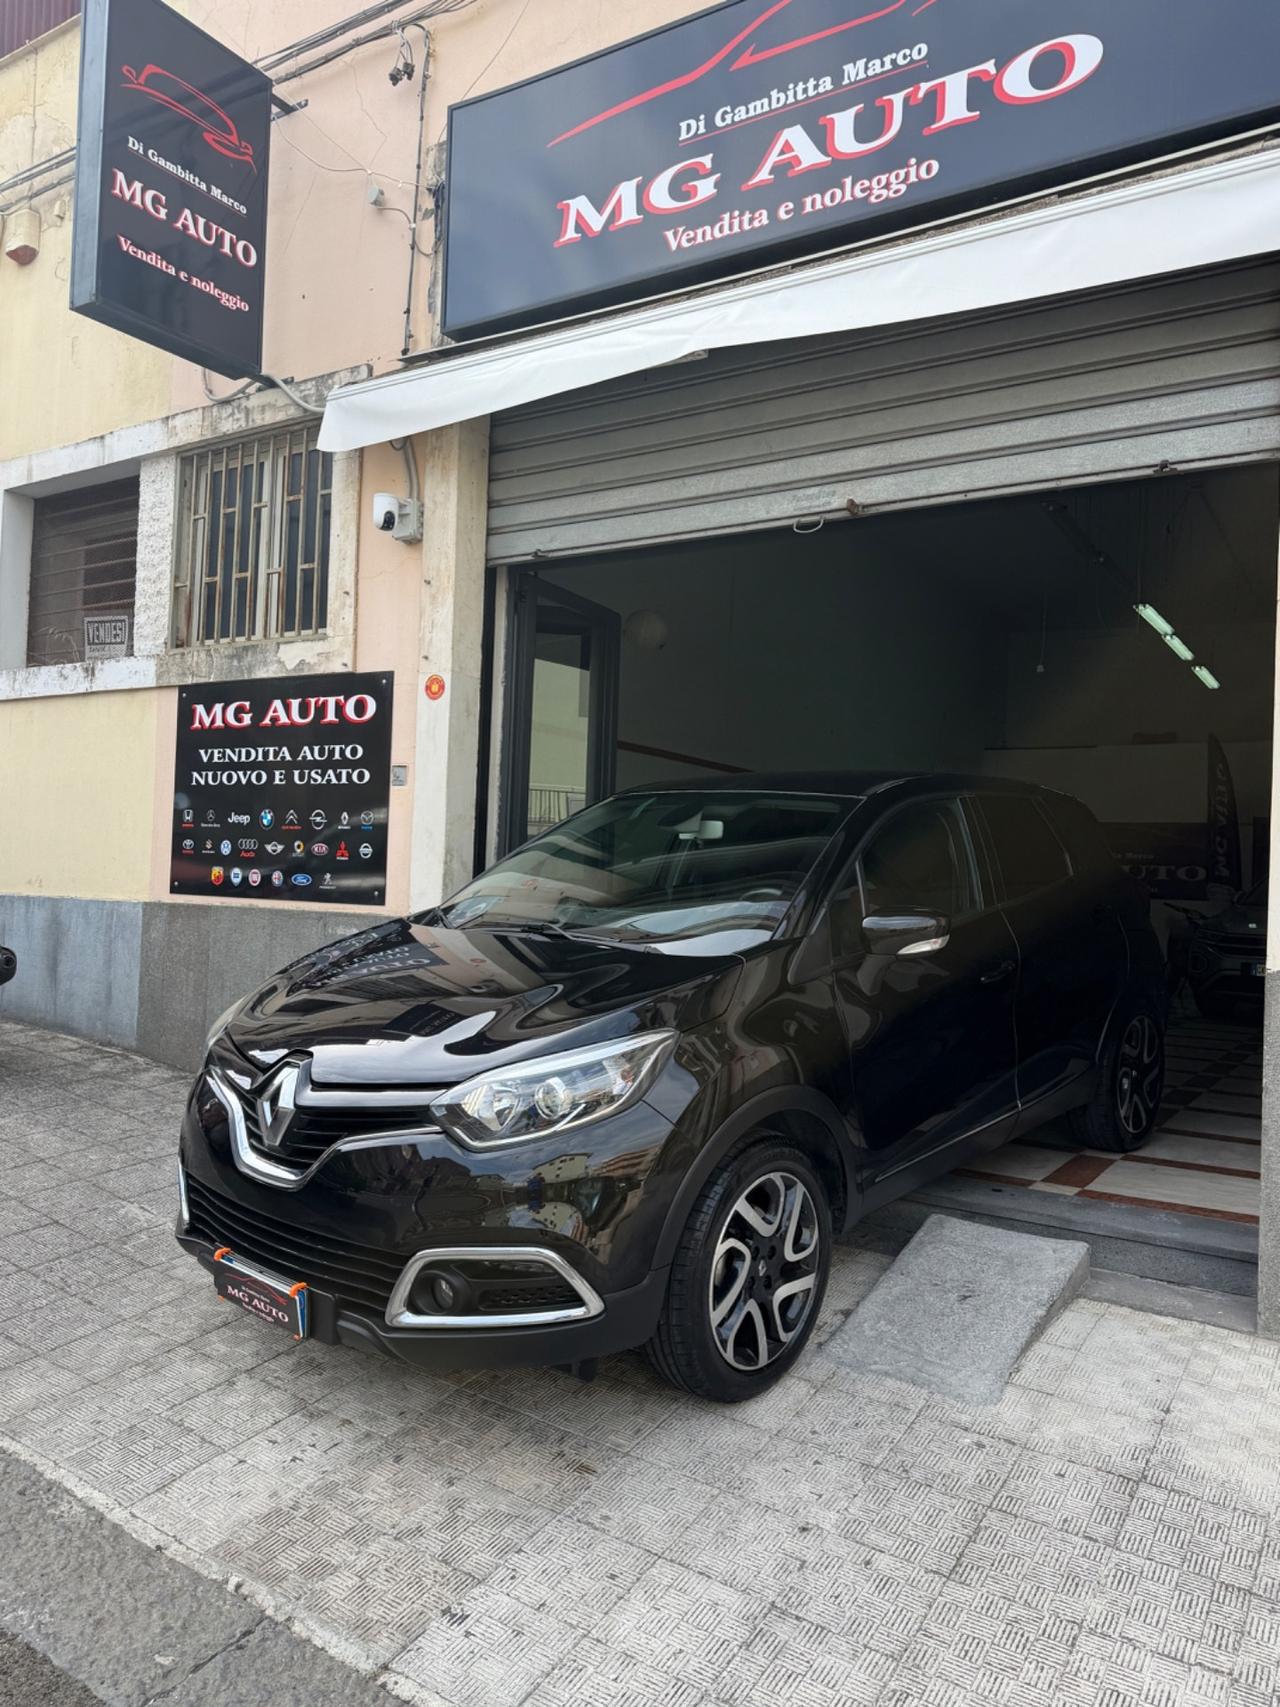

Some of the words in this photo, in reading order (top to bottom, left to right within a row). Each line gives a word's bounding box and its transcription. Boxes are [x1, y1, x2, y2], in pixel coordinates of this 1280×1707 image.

[678, 115, 706, 142] Di
[714, 75, 833, 127] Gambitta
[842, 43, 928, 86] Marco
[553, 153, 722, 248] MG
[740, 33, 1104, 191] AUTO
[127, 135, 145, 154] Di
[147, 149, 208, 192] Gambitta
[210, 185, 247, 215] Marco
[112, 167, 168, 220] MG
[173, 207, 257, 267] AUTO
[663, 205, 769, 253] Vendita
[777, 200, 794, 221] e
[801, 157, 940, 215] noleggio
[116, 233, 176, 276] Vendita
[178, 270, 188, 282] e
[190, 275, 249, 312] noleggio
[88, 621, 125, 644] VENDESI
[190, 701, 253, 730] MG
[259, 694, 377, 726] AUTO
[190, 769, 267, 786] NUOVO
[272, 770, 286, 785] E
[293, 768, 371, 785] USATO
[198, 746, 293, 763] VENDITA
[296, 744, 364, 761] AUTO
[227, 812, 251, 826] Jeep
[227, 1285, 249, 1302] MG
[252, 1298, 289, 1322] AUTO
